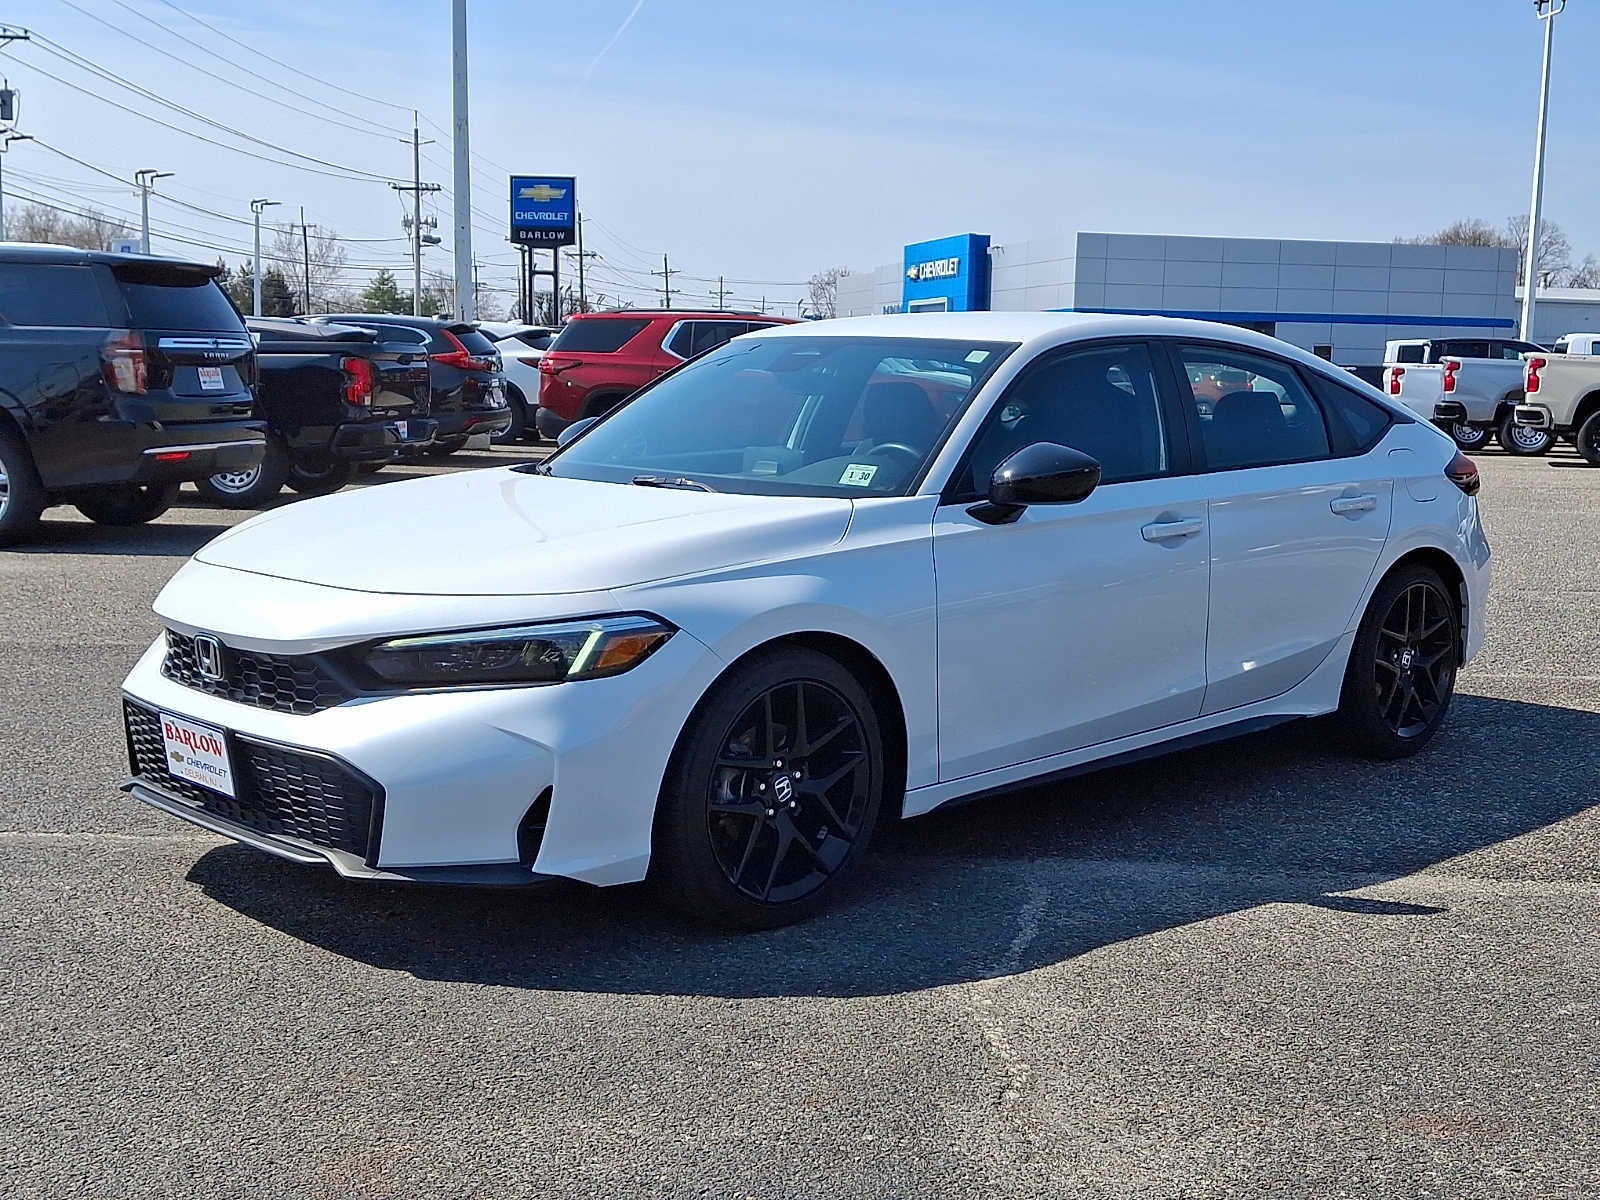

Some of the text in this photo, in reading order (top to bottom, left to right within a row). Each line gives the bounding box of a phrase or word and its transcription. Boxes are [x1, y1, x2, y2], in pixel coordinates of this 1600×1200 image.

[515, 211, 568, 221] CHEVROLET
[520, 230, 565, 239] BARLOW
[919, 257, 960, 280] CHEVROLET
[858, 471, 871, 480] 30
[163, 722, 223, 757] BARLOW
[186, 757, 227, 778] CHEVROLET
